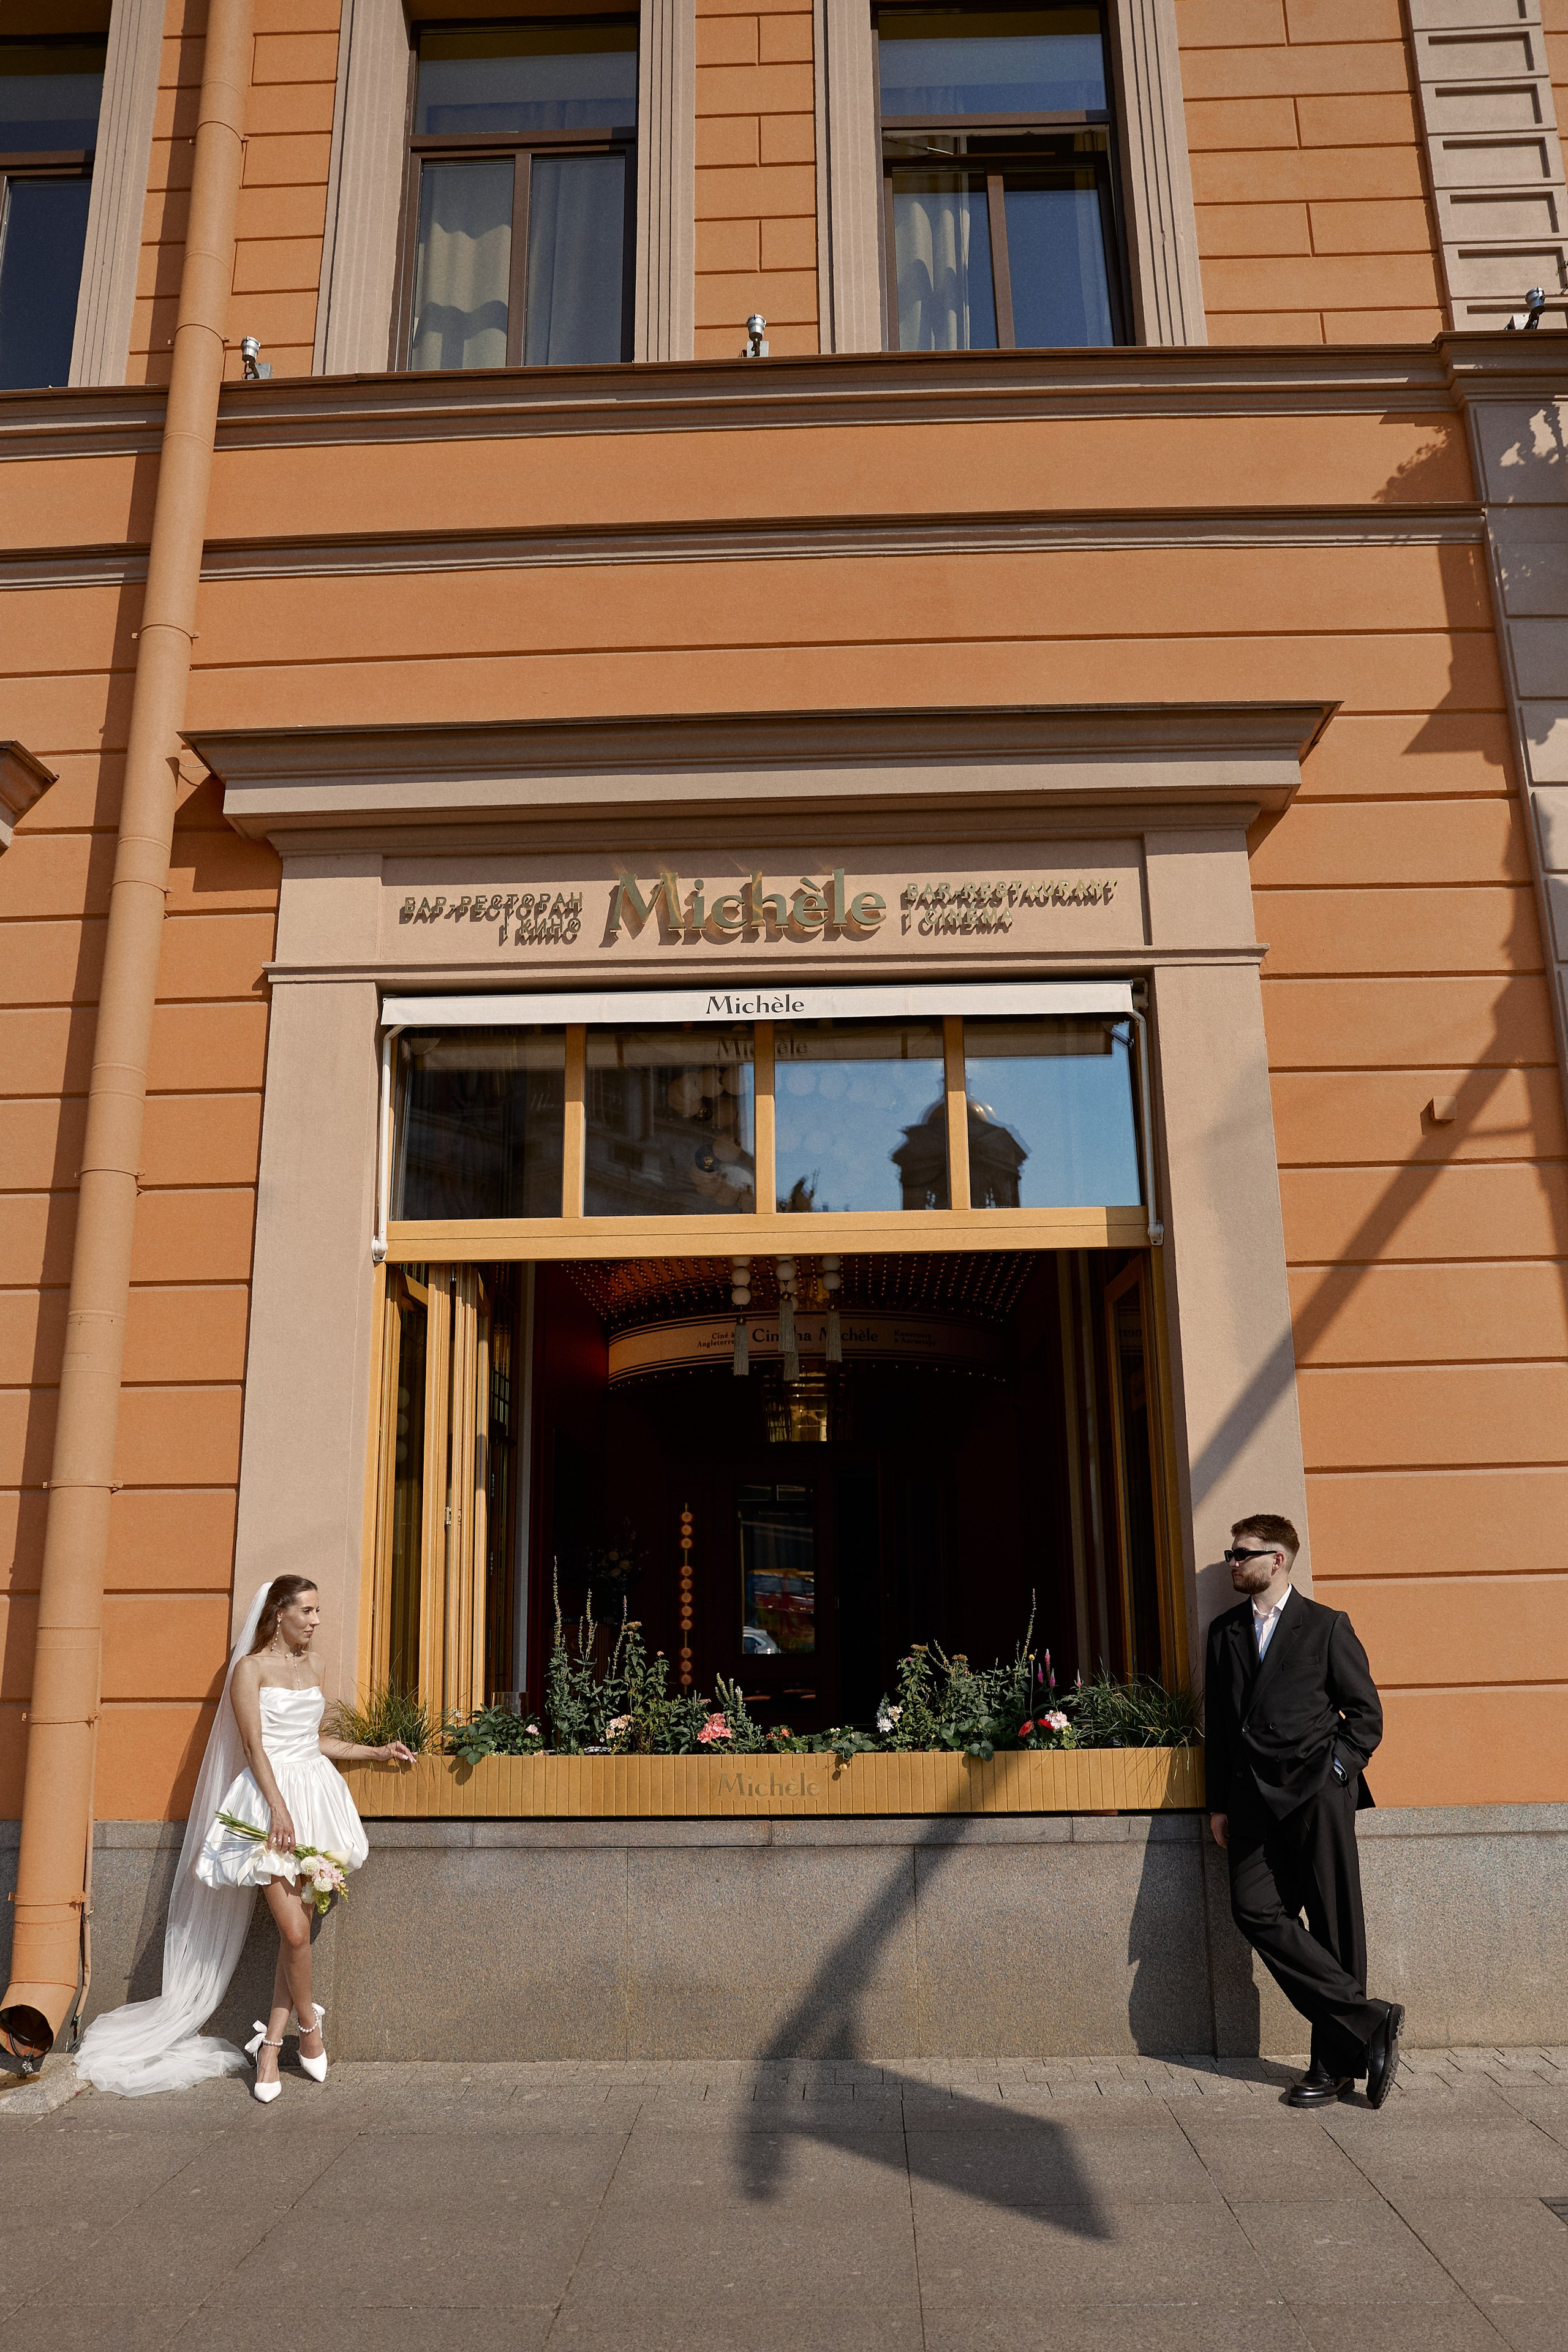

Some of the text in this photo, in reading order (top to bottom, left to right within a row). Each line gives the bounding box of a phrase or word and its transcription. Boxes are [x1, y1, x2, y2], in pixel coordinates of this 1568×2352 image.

[907, 878, 1118, 900] BAR-RESTAURANT
[608, 869, 886, 932] Michèle
[519, 917, 581, 935] КИНО
[706, 994, 805, 1014] Michèle
[716, 1036, 808, 1057] Micèle
[717, 1773, 820, 1797] Michèle
